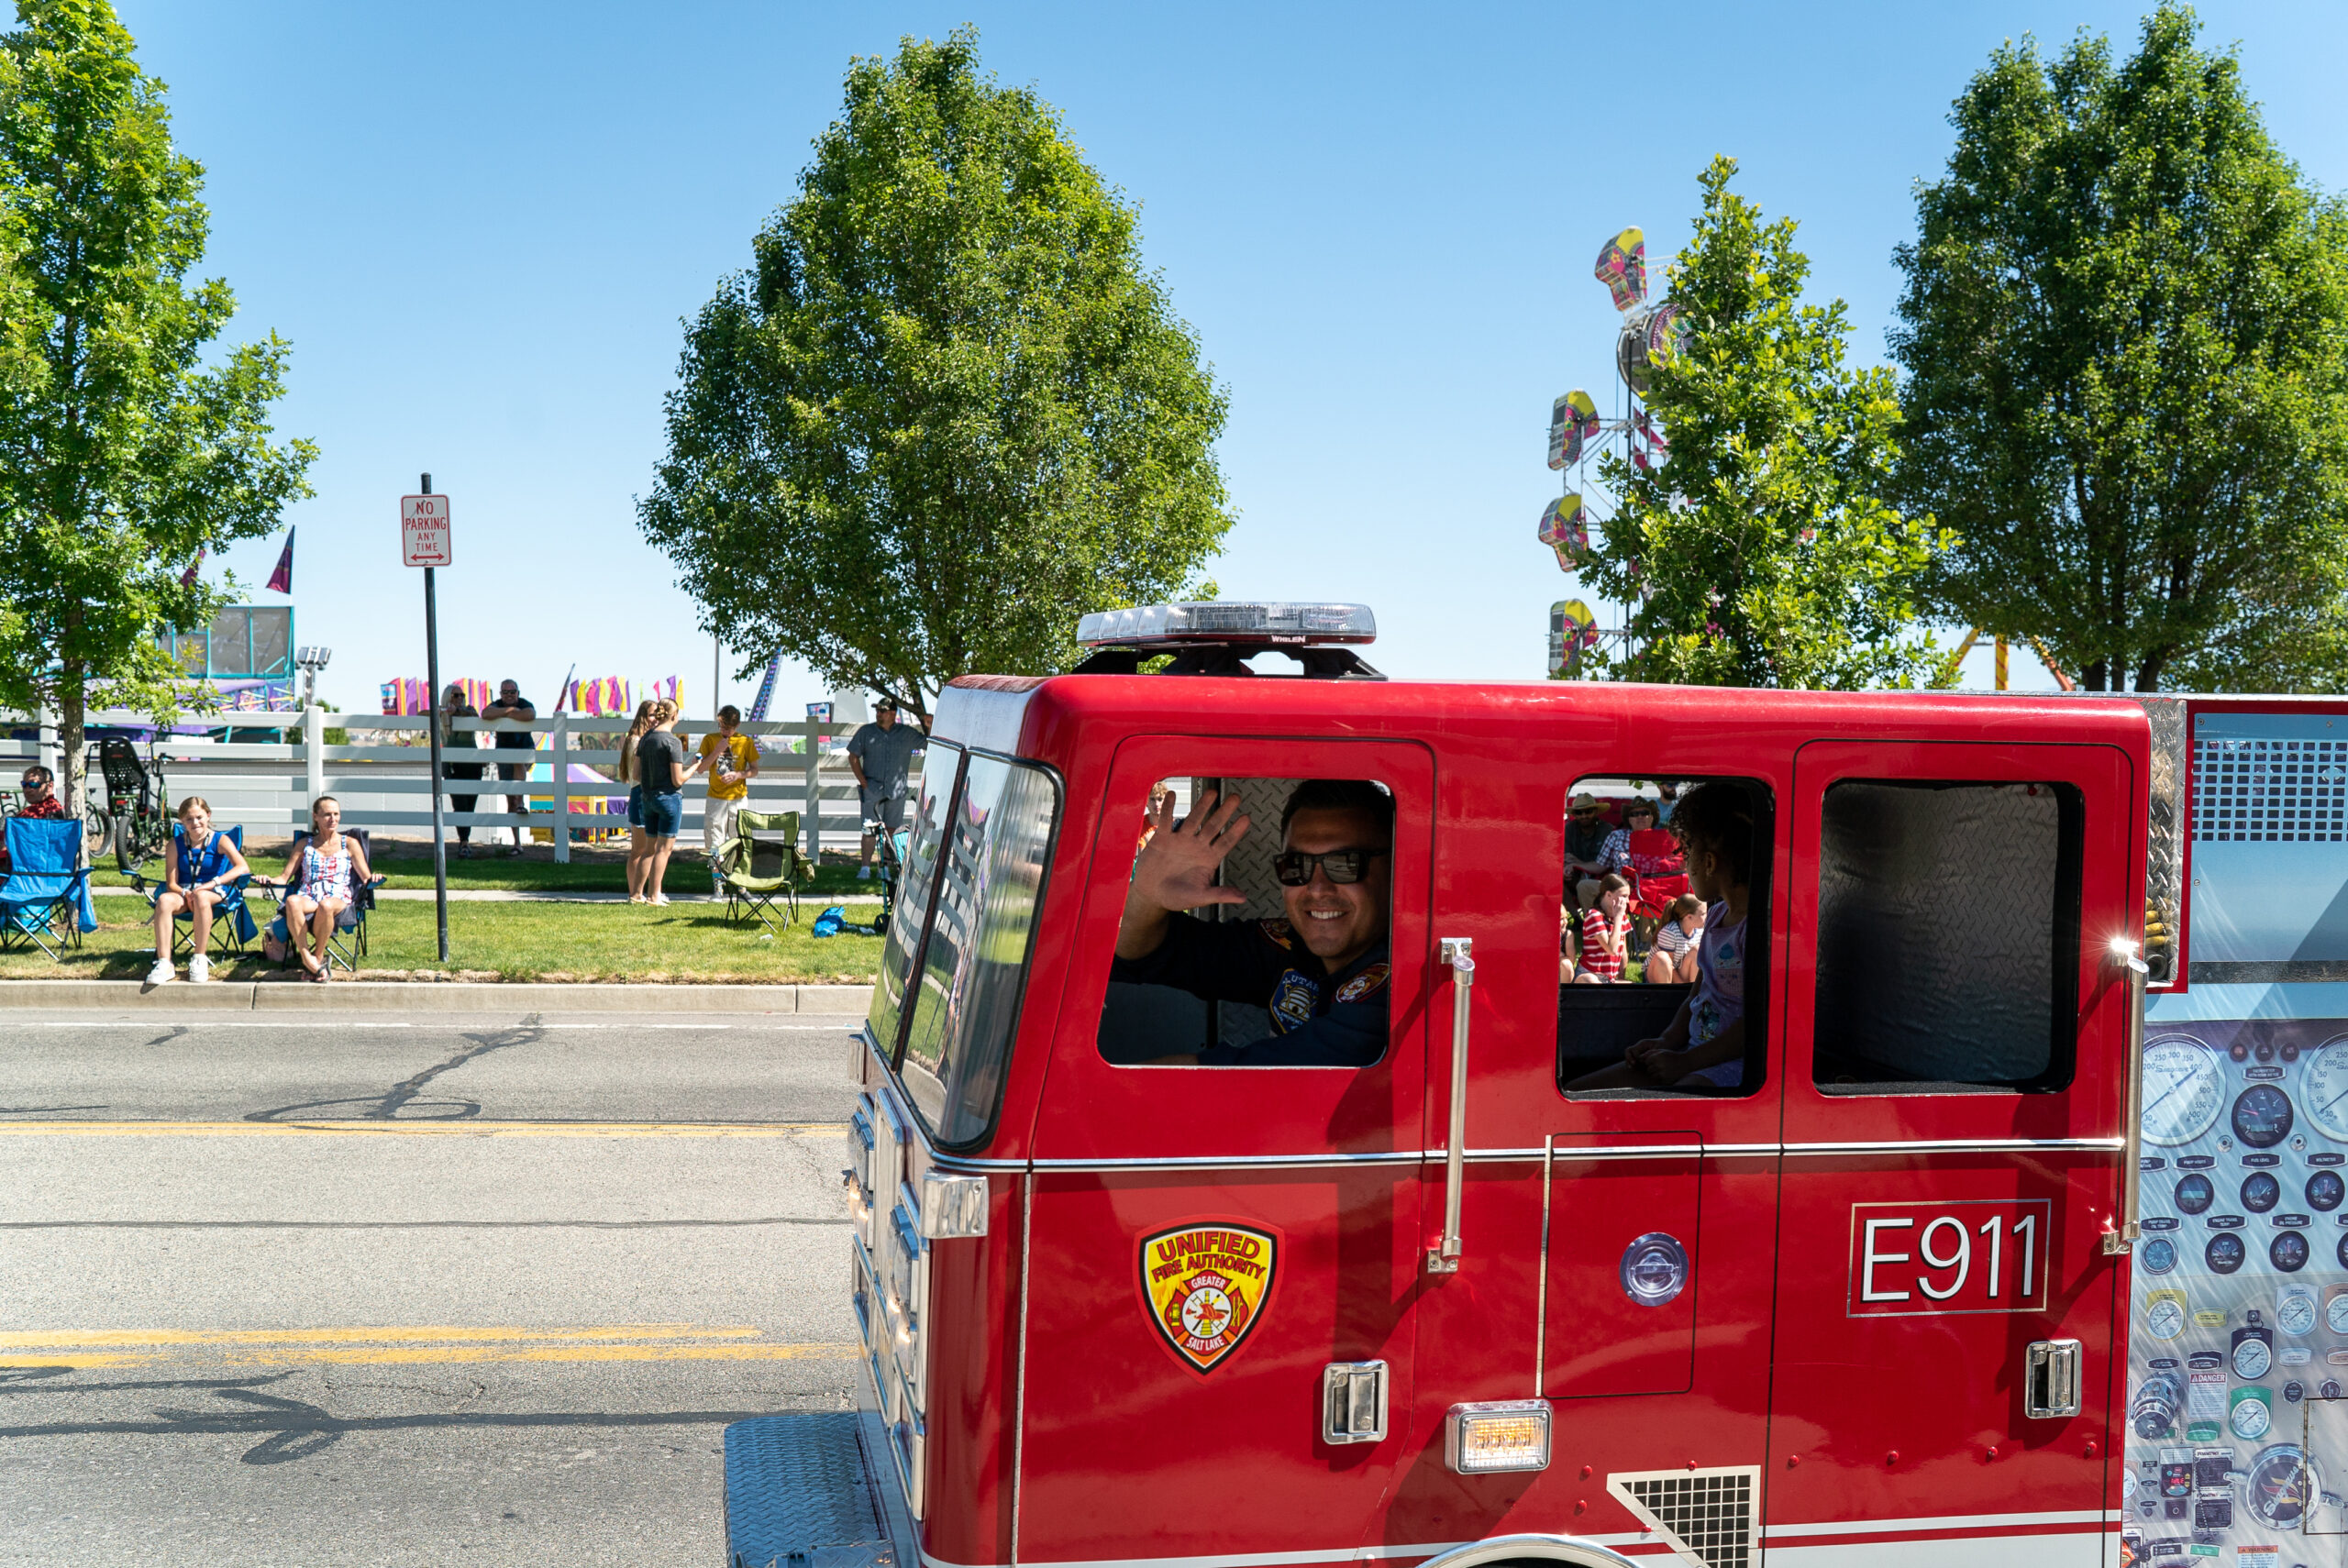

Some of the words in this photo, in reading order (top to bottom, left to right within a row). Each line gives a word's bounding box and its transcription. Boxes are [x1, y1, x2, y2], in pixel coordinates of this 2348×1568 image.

[416, 501, 434, 515] NO
[405, 517, 447, 531] PARKING
[417, 532, 436, 541] ANY
[415, 543, 438, 552] TIME
[1271, 635, 1307, 643] WHELEN
[1157, 1231, 1261, 1262] UNIFIED
[1860, 1214, 2036, 1304] E911
[1151, 1258, 1183, 1284] FIRE
[1187, 1253, 1267, 1280] AUTHORITY
[1191, 1275, 1226, 1289] GREATER
[1186, 1336, 1205, 1352] SALT
[1205, 1337, 1225, 1351] LAKE
[2198, 1374, 2225, 1382] DANGER
